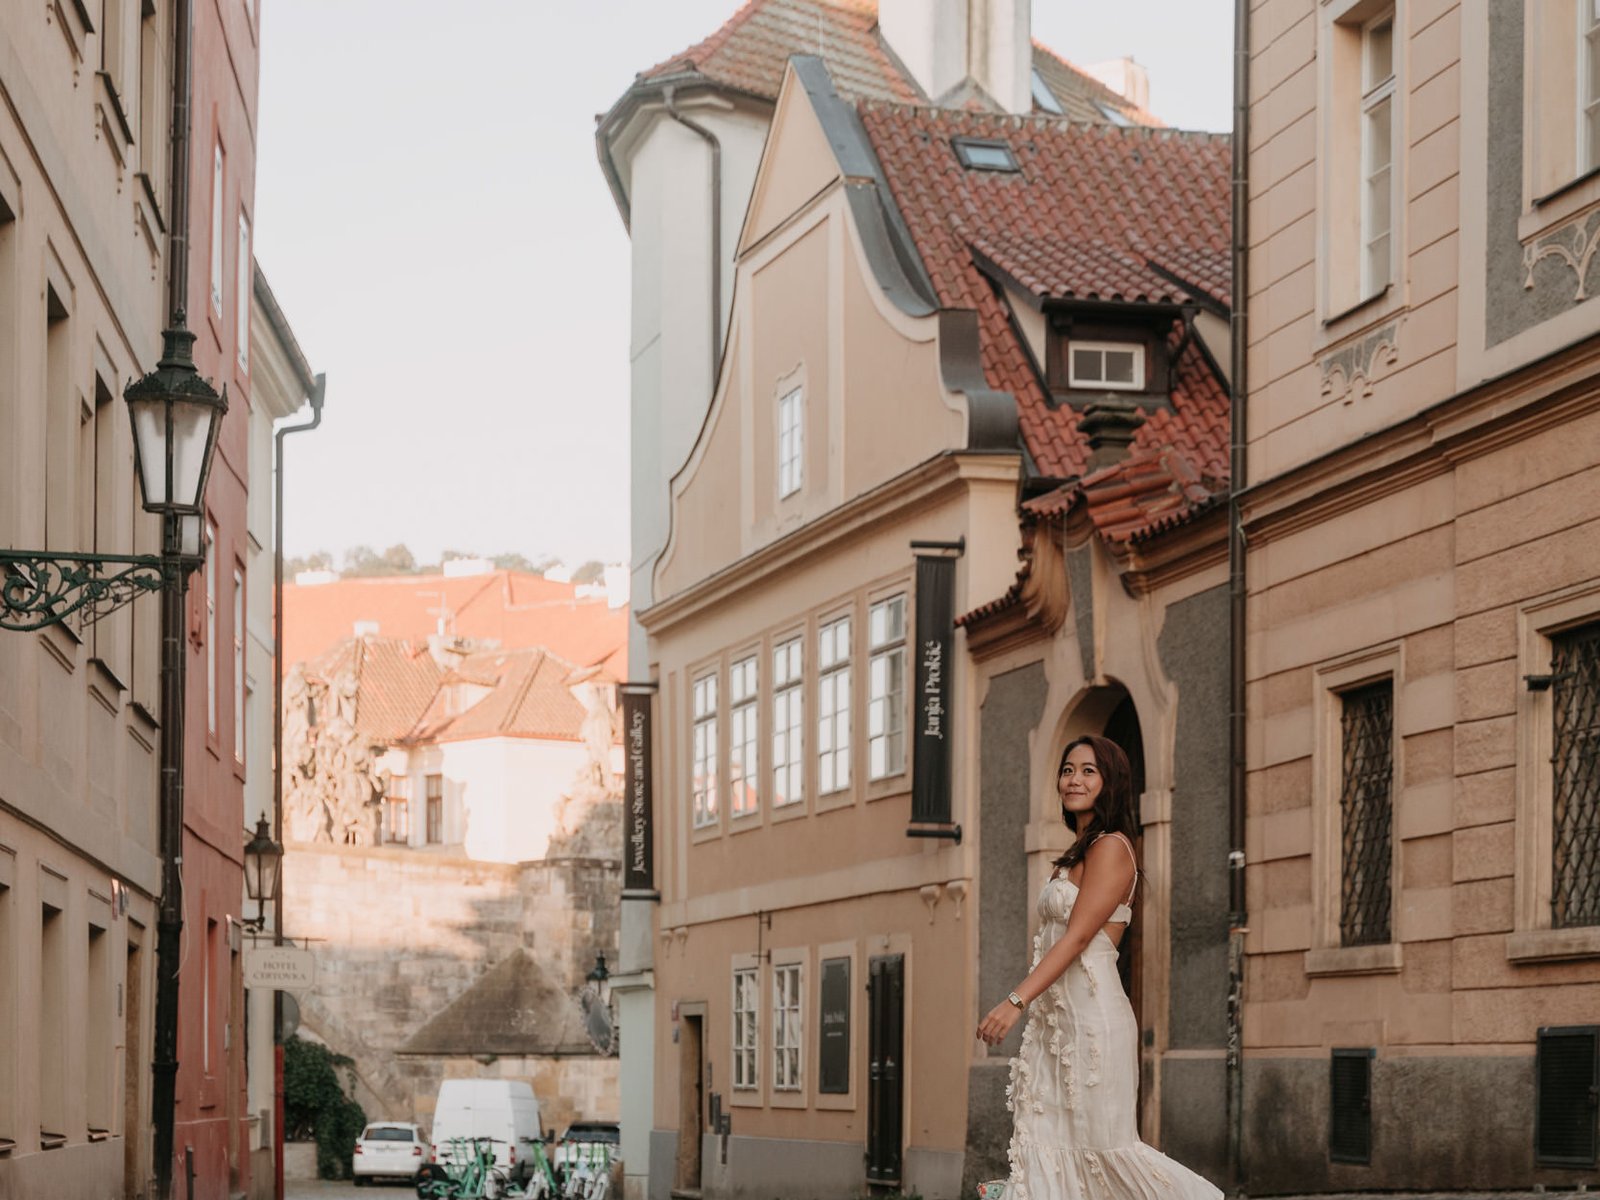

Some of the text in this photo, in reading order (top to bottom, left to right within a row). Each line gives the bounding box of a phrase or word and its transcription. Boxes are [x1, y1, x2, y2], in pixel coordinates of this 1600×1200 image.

[923, 697, 945, 740] Janja
[629, 709, 647, 874] Jewellery Store and Gallery
[262, 961, 298, 971] HOTEL
